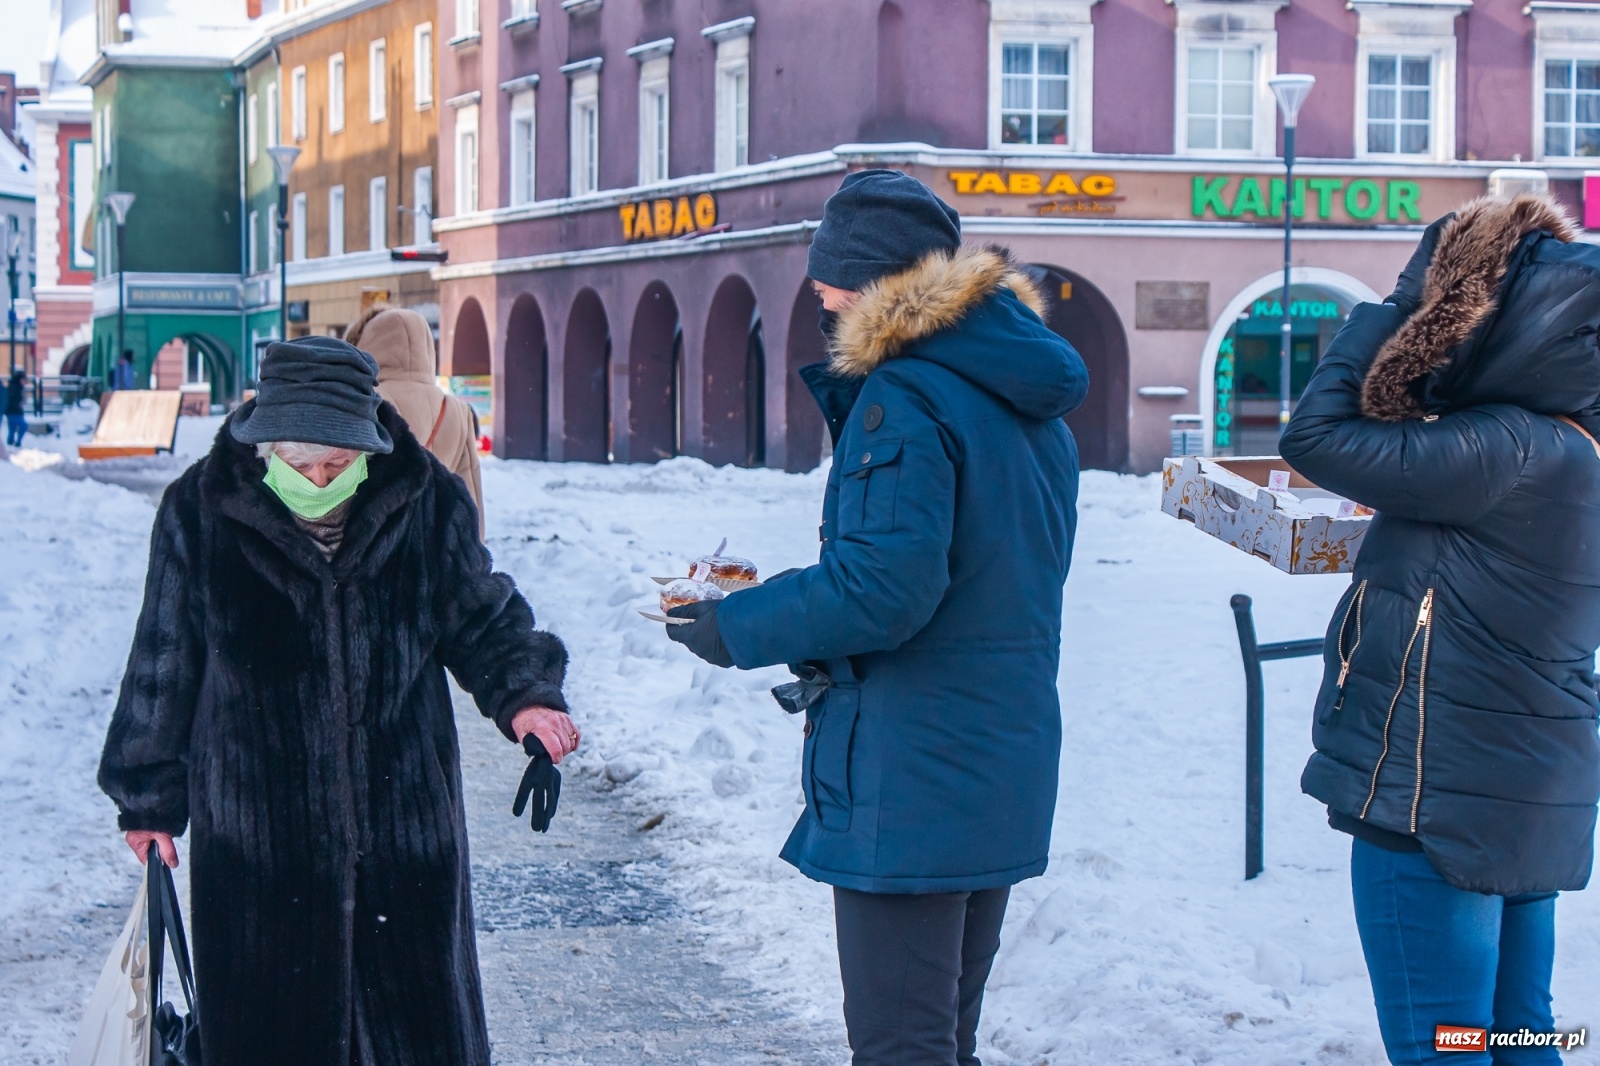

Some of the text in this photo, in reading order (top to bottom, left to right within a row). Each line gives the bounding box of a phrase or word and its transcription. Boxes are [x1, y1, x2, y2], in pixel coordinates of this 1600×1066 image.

[949, 171, 1117, 197] TABAC
[1192, 175, 1423, 221] KANTOR
[620, 193, 716, 240] TABAC
[1255, 300, 1338, 317] KANTOR
[1217, 338, 1233, 446] KANTOR
